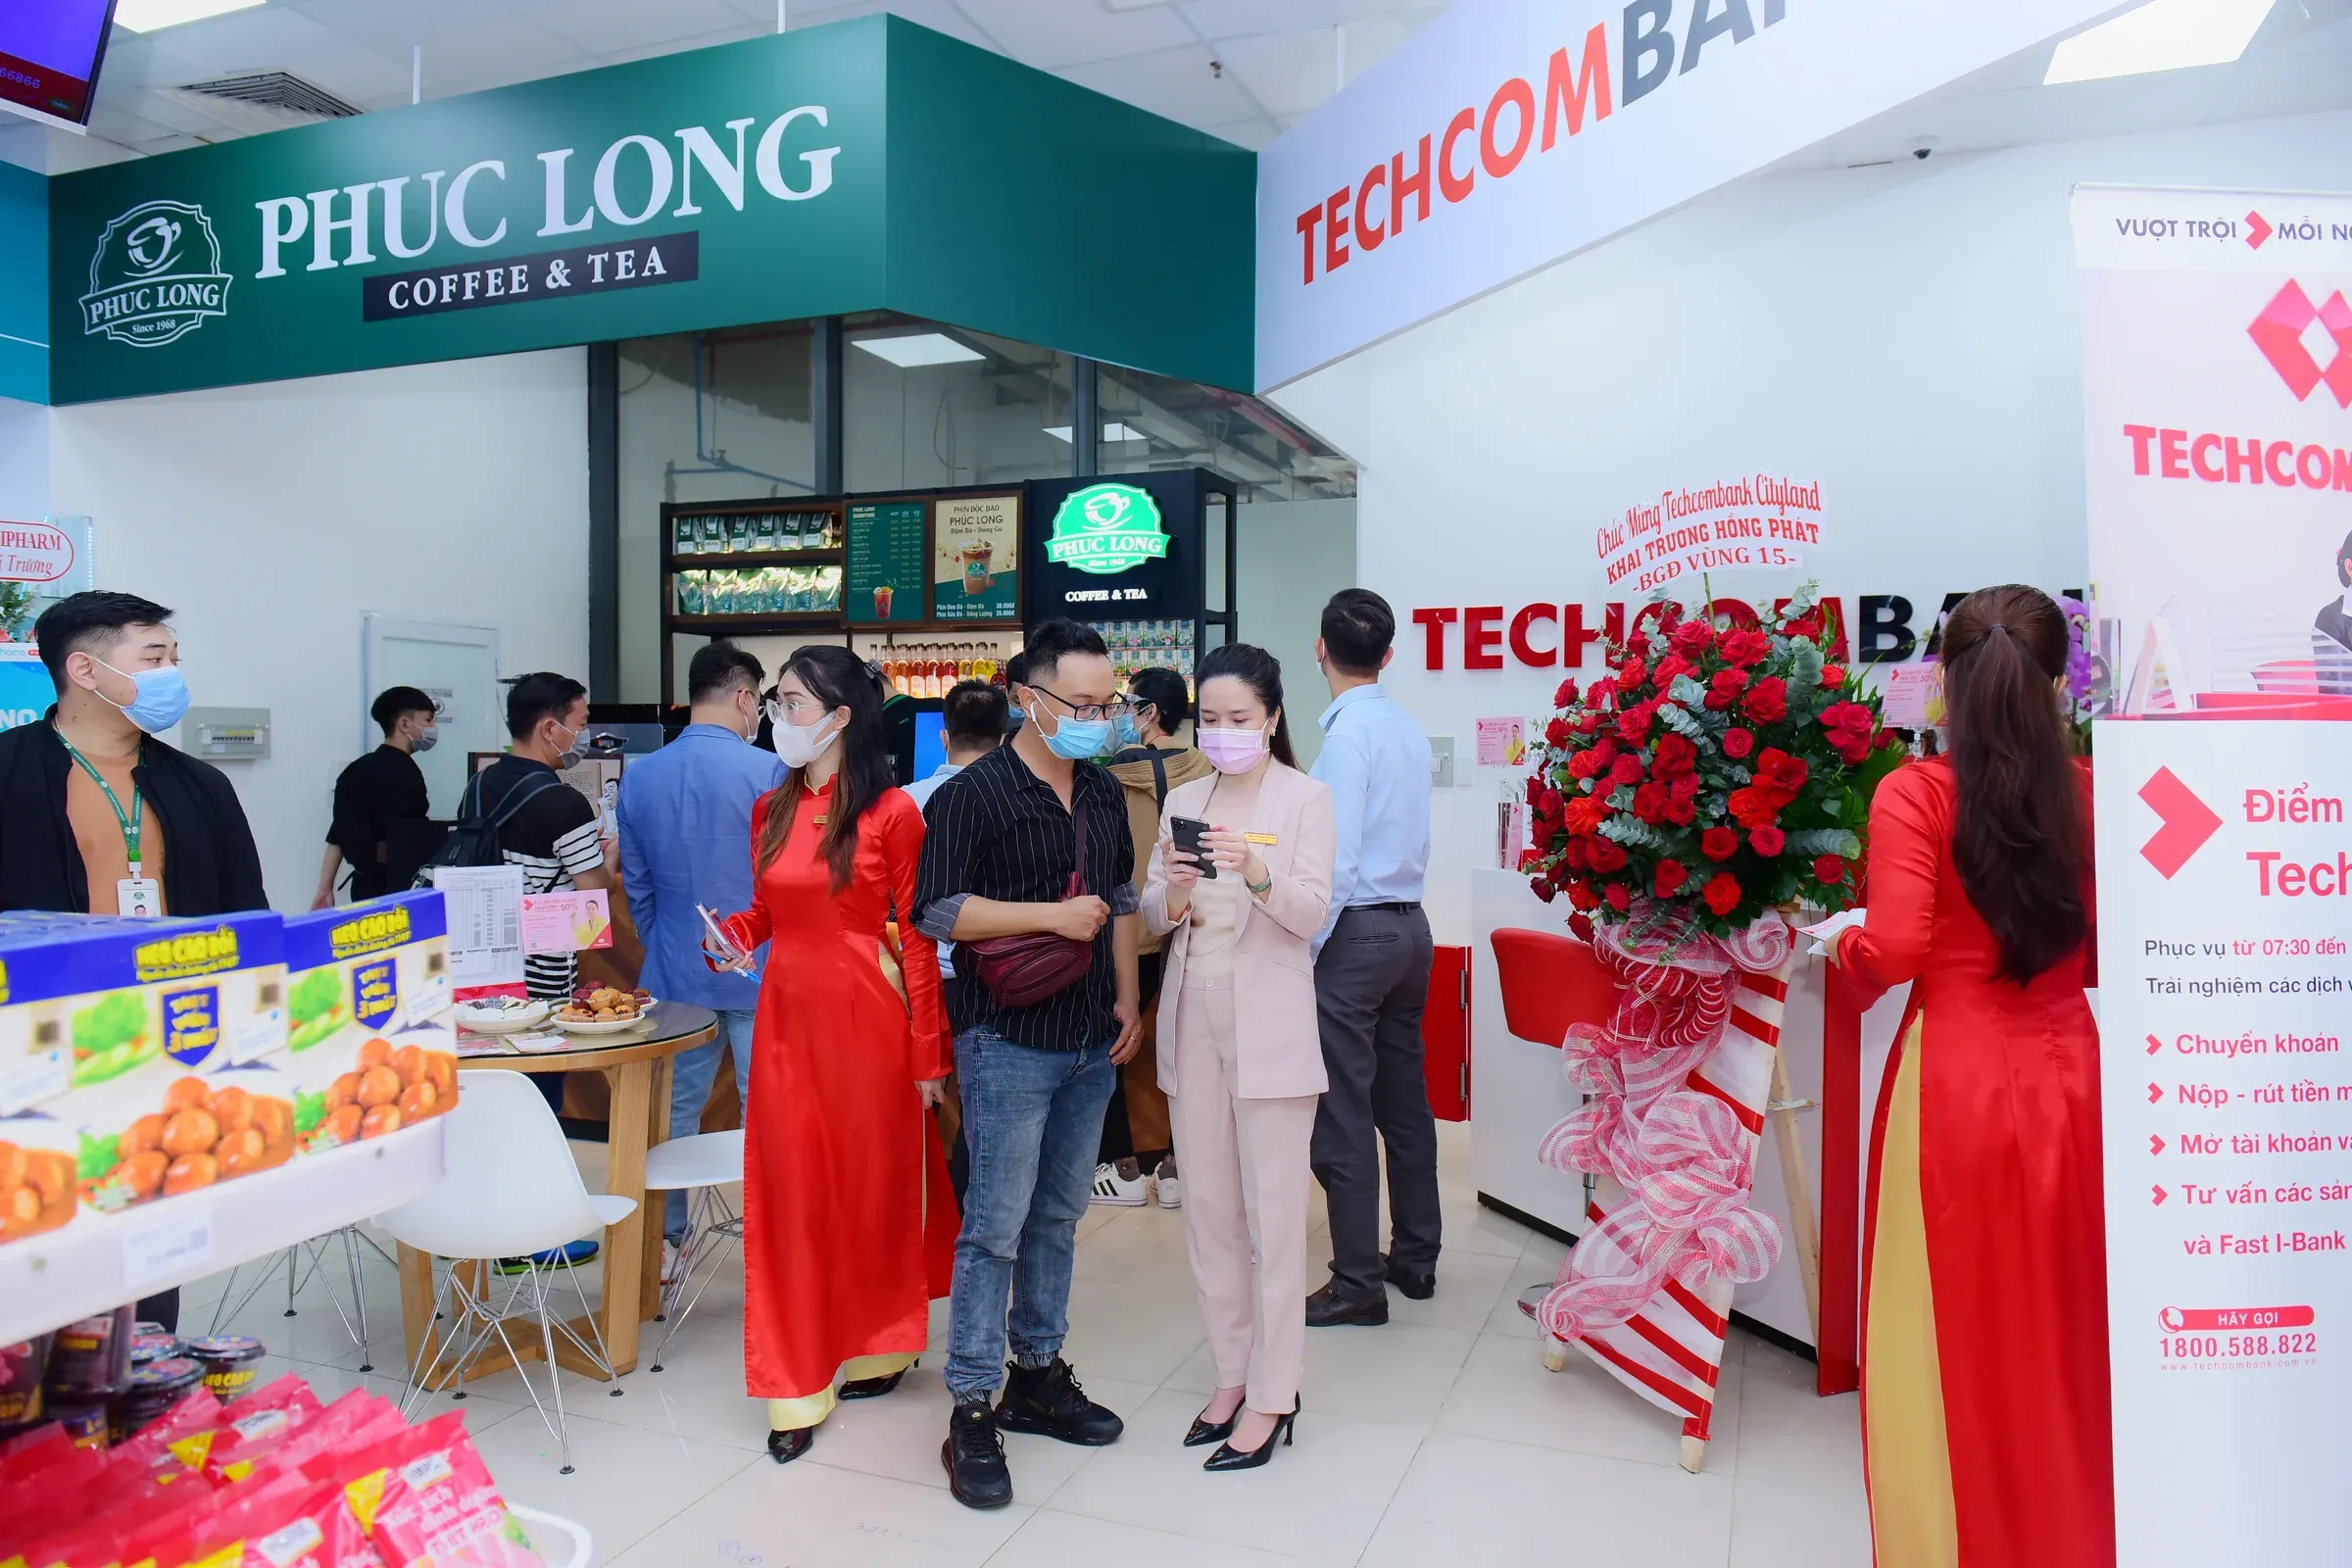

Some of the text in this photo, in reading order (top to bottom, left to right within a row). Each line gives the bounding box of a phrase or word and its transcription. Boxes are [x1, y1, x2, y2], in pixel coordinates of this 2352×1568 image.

[1297, 0, 1786, 286] TECHCOMBA
[255, 105, 841, 279] PHUC LONG
[2116, 215, 2352, 242] VƯỢT TRỘI MỖI N
[388, 246, 667, 310] COFFEE & TEA
[90, 284, 220, 324] PHUC LONG
[131, 318, 176, 333] Since 1968
[950, 514, 1004, 525] PHÚC LONG
[1596, 473, 1822, 560] Chúc Mừng Techcombank Cityland
[1052, 535, 1162, 559] PHUC LONG
[1606, 549, 1642, 585] KHAI
[1714, 512, 1762, 540] HỒNG
[1768, 516, 1819, 544] PHÁT
[1686, 546, 1750, 571] VÙNG
[1065, 588, 1148, 602] COFFEE & TEA
[2242, 781, 2343, 823] Điểm
[2145, 937, 2346, 958] Phục vụ từ 07:30 đến
[2145, 976, 2181, 994] Trải
[2188, 976, 2262, 997] nghiệm
[2269, 977, 2301, 993] các
[2306, 976, 2342, 995] dịch
[2176, 1030, 2339, 1058] Chuyển khoản
[2179, 1084, 2229, 1108] Nộp
[2254, 1083, 2284, 1103] rút
[2291, 1079, 2329, 1102] tiền
[2180, 1131, 2352, 1154] Mở tài khoản v
[2181, 1184, 2218, 1204] Tư
[2226, 1180, 2267, 1203] vấn
[2275, 1182, 2313, 1202] các
[2183, 1230, 2346, 1254] và Fast I-Bank
[2218, 1311, 2278, 1327] HÃY GỌI
[2160, 1333, 2317, 1357] 1800.588.822
